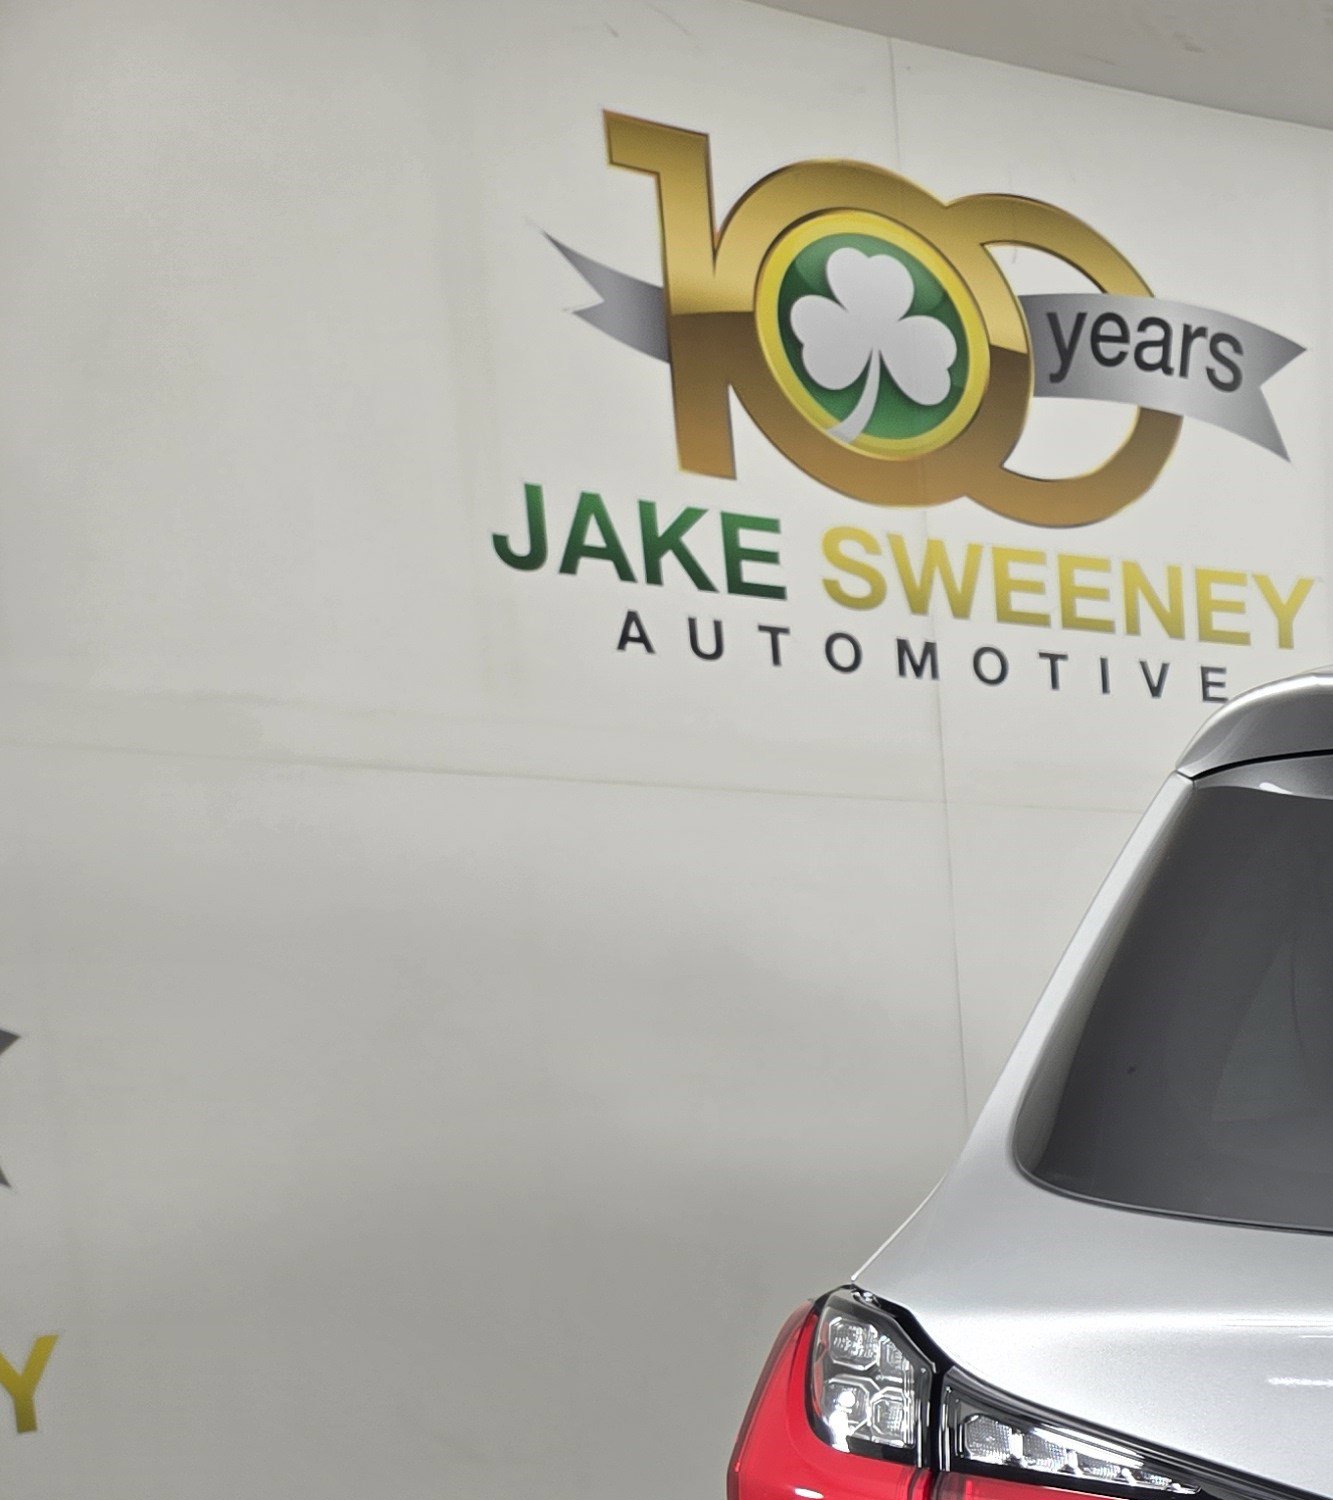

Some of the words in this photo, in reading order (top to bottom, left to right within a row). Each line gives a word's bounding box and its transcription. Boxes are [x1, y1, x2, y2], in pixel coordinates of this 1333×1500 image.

[602, 109, 1184, 528] 100
[1046, 311, 1245, 393] years
[491, 483, 789, 601] JAKE
[821, 527, 1317, 651] SWEENEY
[616, 611, 1231, 703] AUTOMOTIVE
